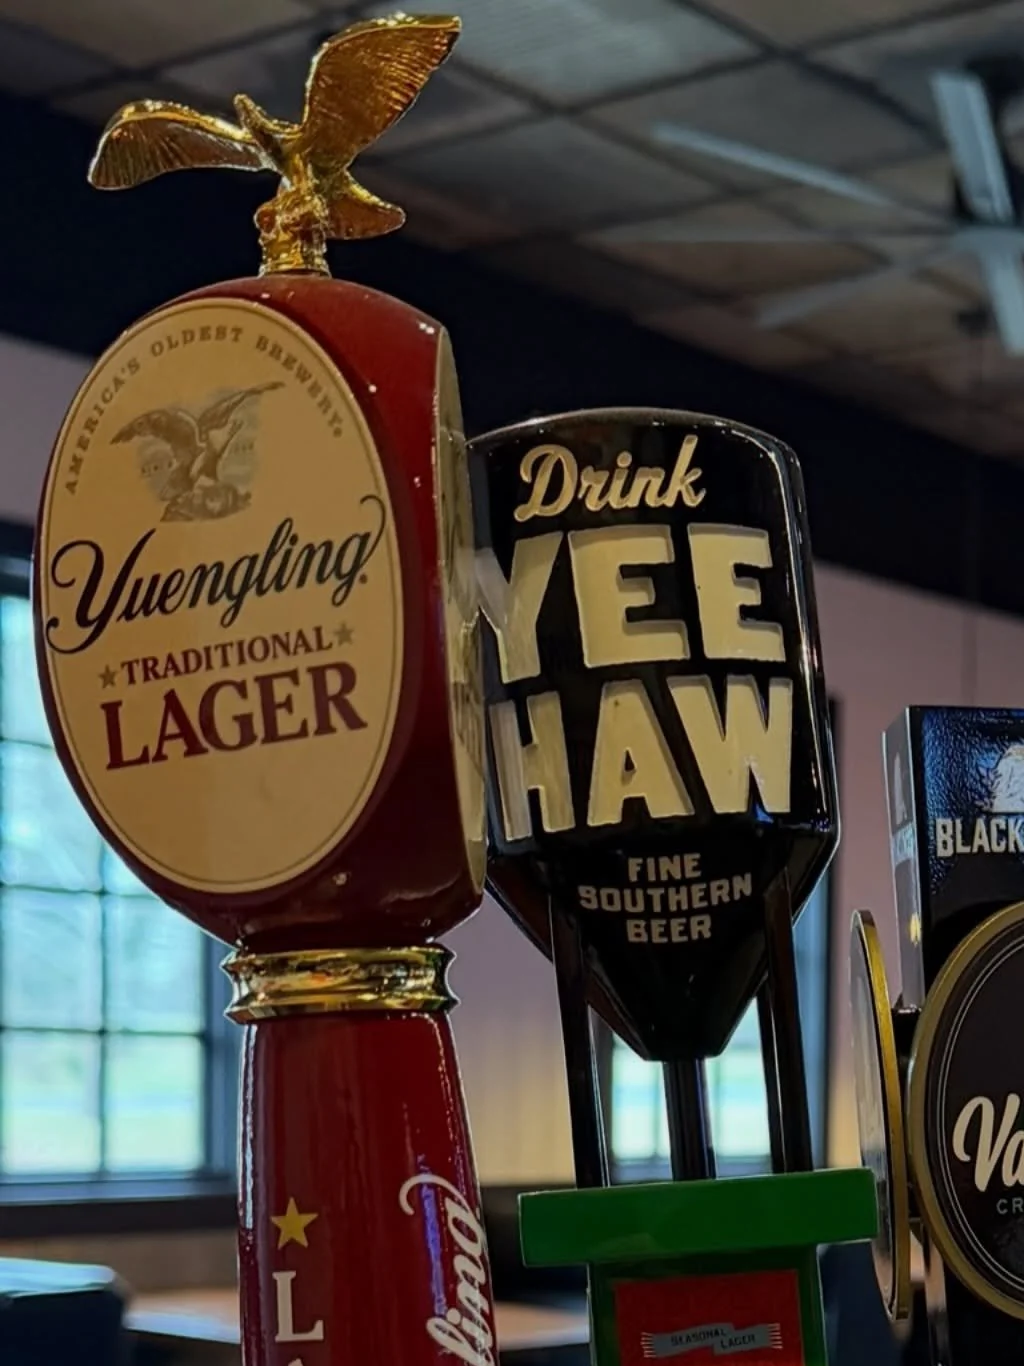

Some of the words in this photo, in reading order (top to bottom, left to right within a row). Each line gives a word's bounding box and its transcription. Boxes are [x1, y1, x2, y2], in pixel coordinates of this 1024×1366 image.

[65, 358, 141, 495] AMERICA'S
[151, 326, 244, 357] OLDEST
[514, 434, 706, 523] Drink
[46, 495, 387, 655] Yuengling
[474, 522, 786, 684] YEE
[121, 625, 334, 687] TRADITIONAL
[101, 661, 368, 770] LAGER
[489, 674, 793, 841] HAW
[578, 873, 752, 911] SOUTHERN
[627, 854, 702, 883] FINE
[626, 916, 712, 944] BEER
[670, 1328, 728, 1347] SEASONAL
[720, 1333, 756, 1350] LAGER
